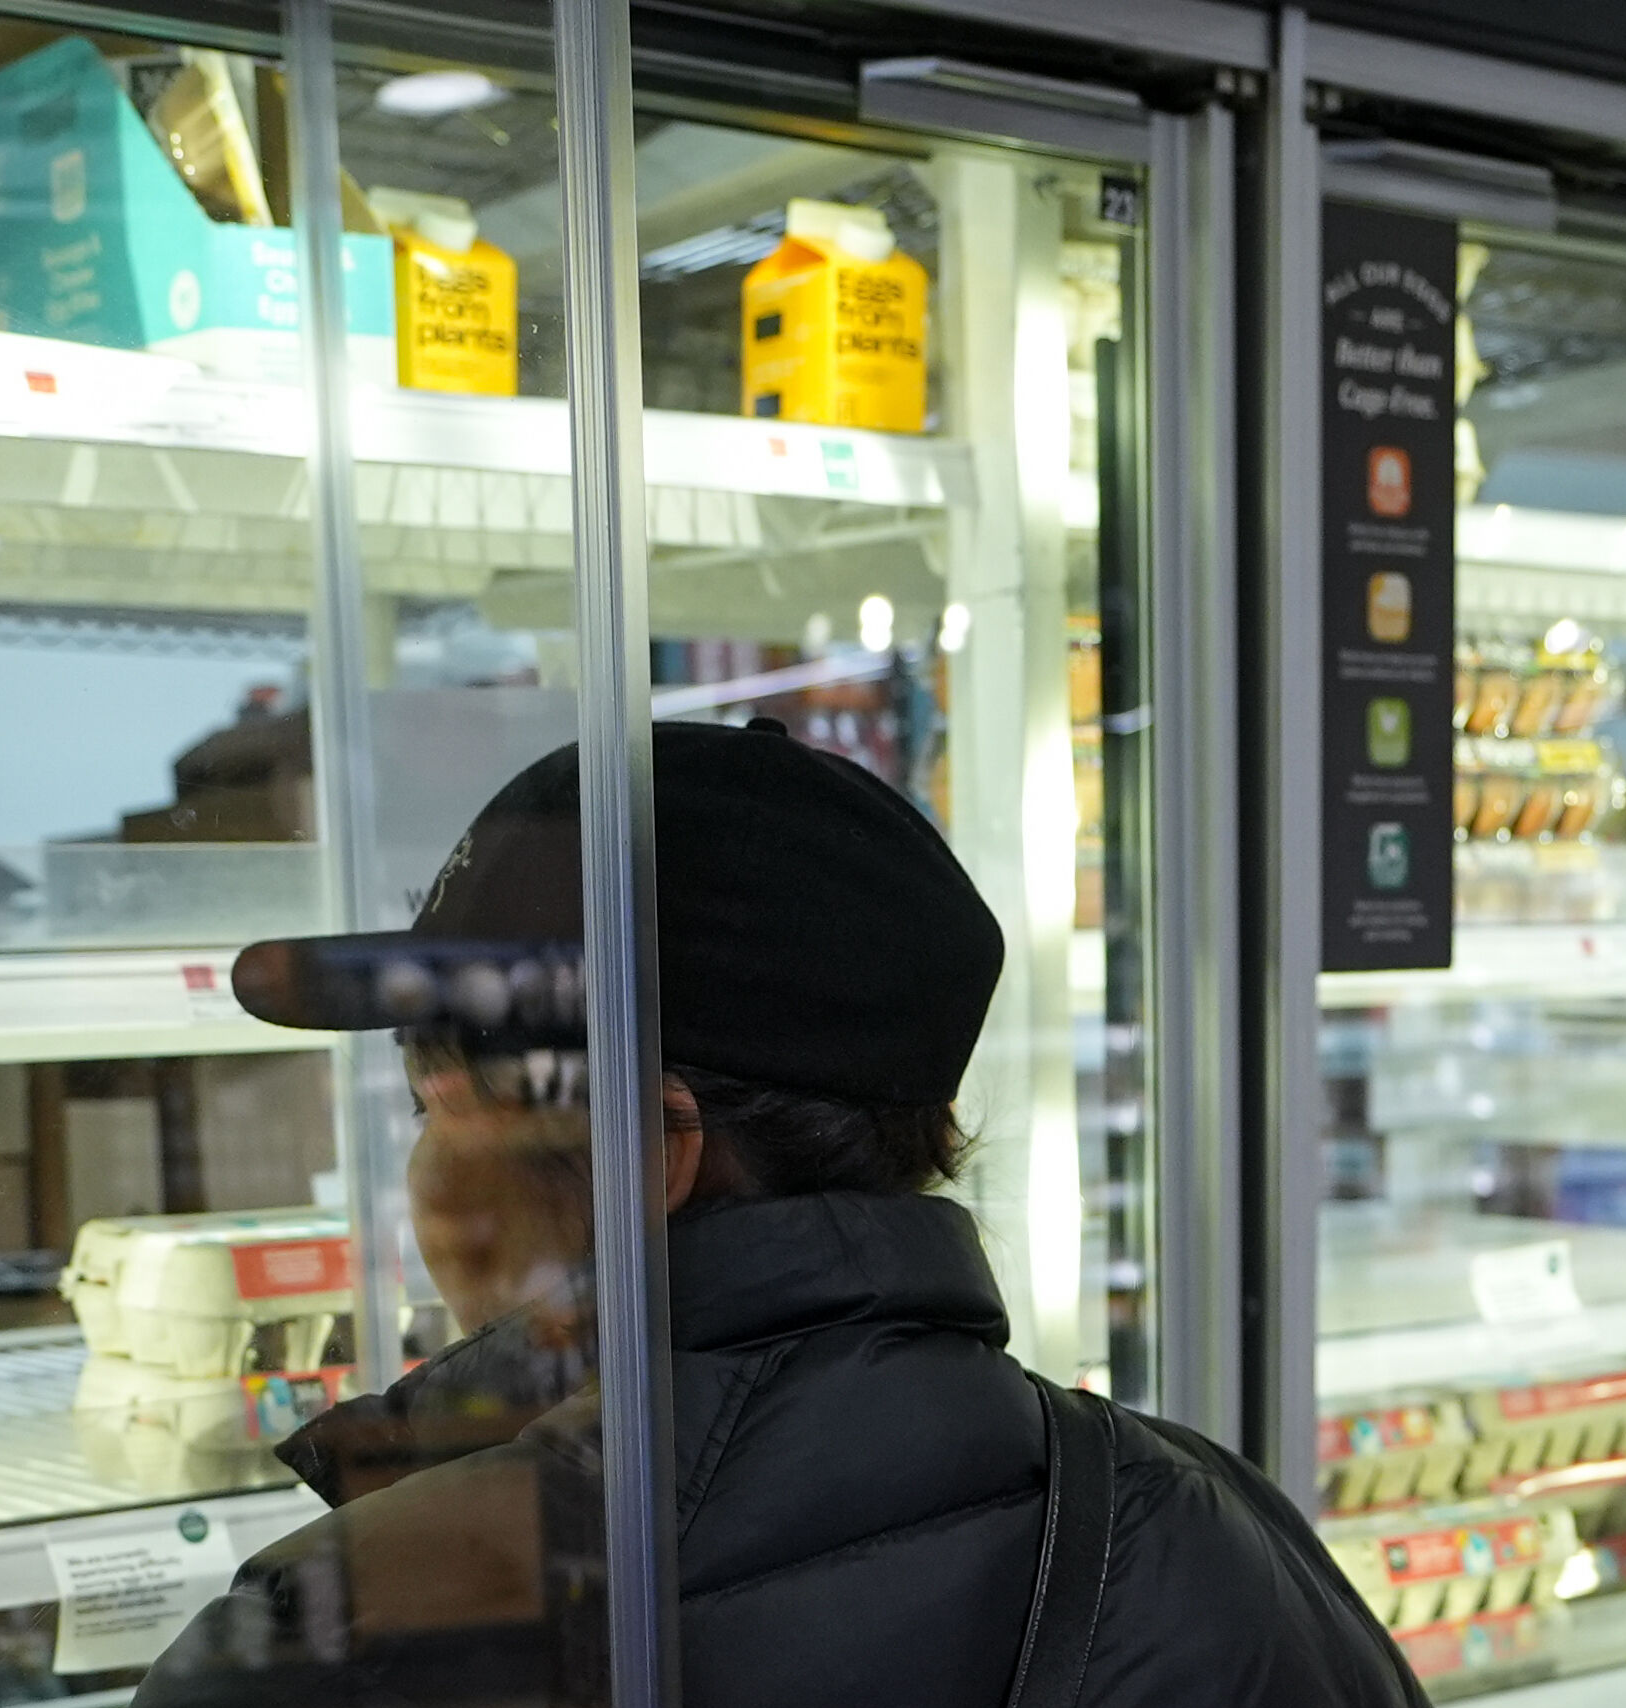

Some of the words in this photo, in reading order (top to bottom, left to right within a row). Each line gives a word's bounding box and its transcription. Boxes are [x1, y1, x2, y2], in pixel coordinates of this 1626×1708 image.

[838, 268, 904, 301] Eggs
[418, 291, 491, 327] from
[838, 300, 905, 328] from
[418, 322, 508, 355] plants
[837, 331, 921, 359] plants
